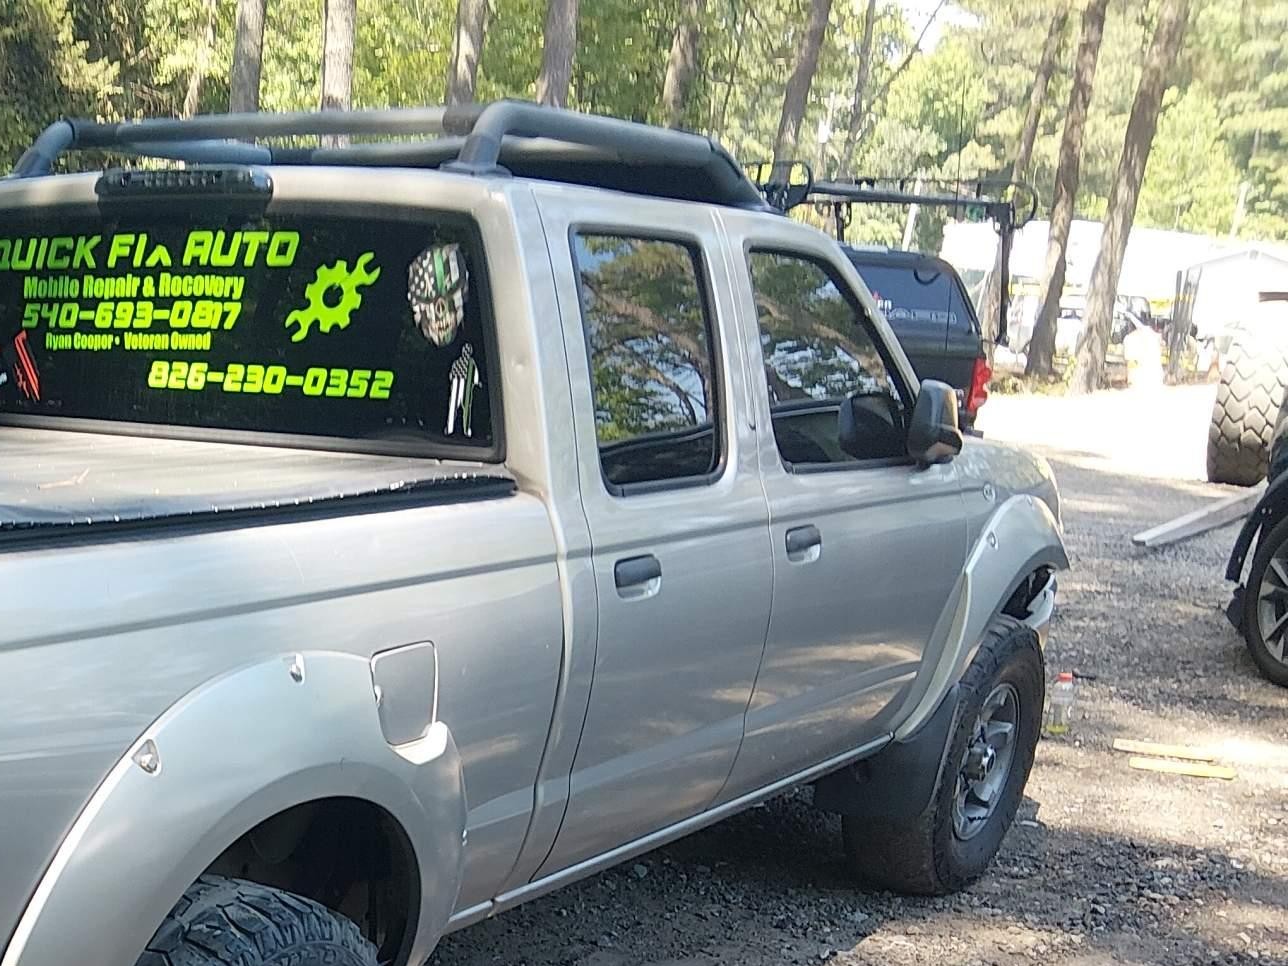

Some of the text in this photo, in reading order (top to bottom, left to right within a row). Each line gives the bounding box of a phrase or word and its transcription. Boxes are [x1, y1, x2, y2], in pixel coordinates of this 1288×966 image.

[182, 229, 300, 268] AUTO
[24, 272, 245, 300] Mobile Repair & Recovery
[22, 300, 242, 329] 540-693-0817
[45, 331, 72, 351] Ryan
[124, 331, 169, 350] Veteran
[171, 330, 211, 350] Owned
[148, 360, 394, 399] 826-230-0352
